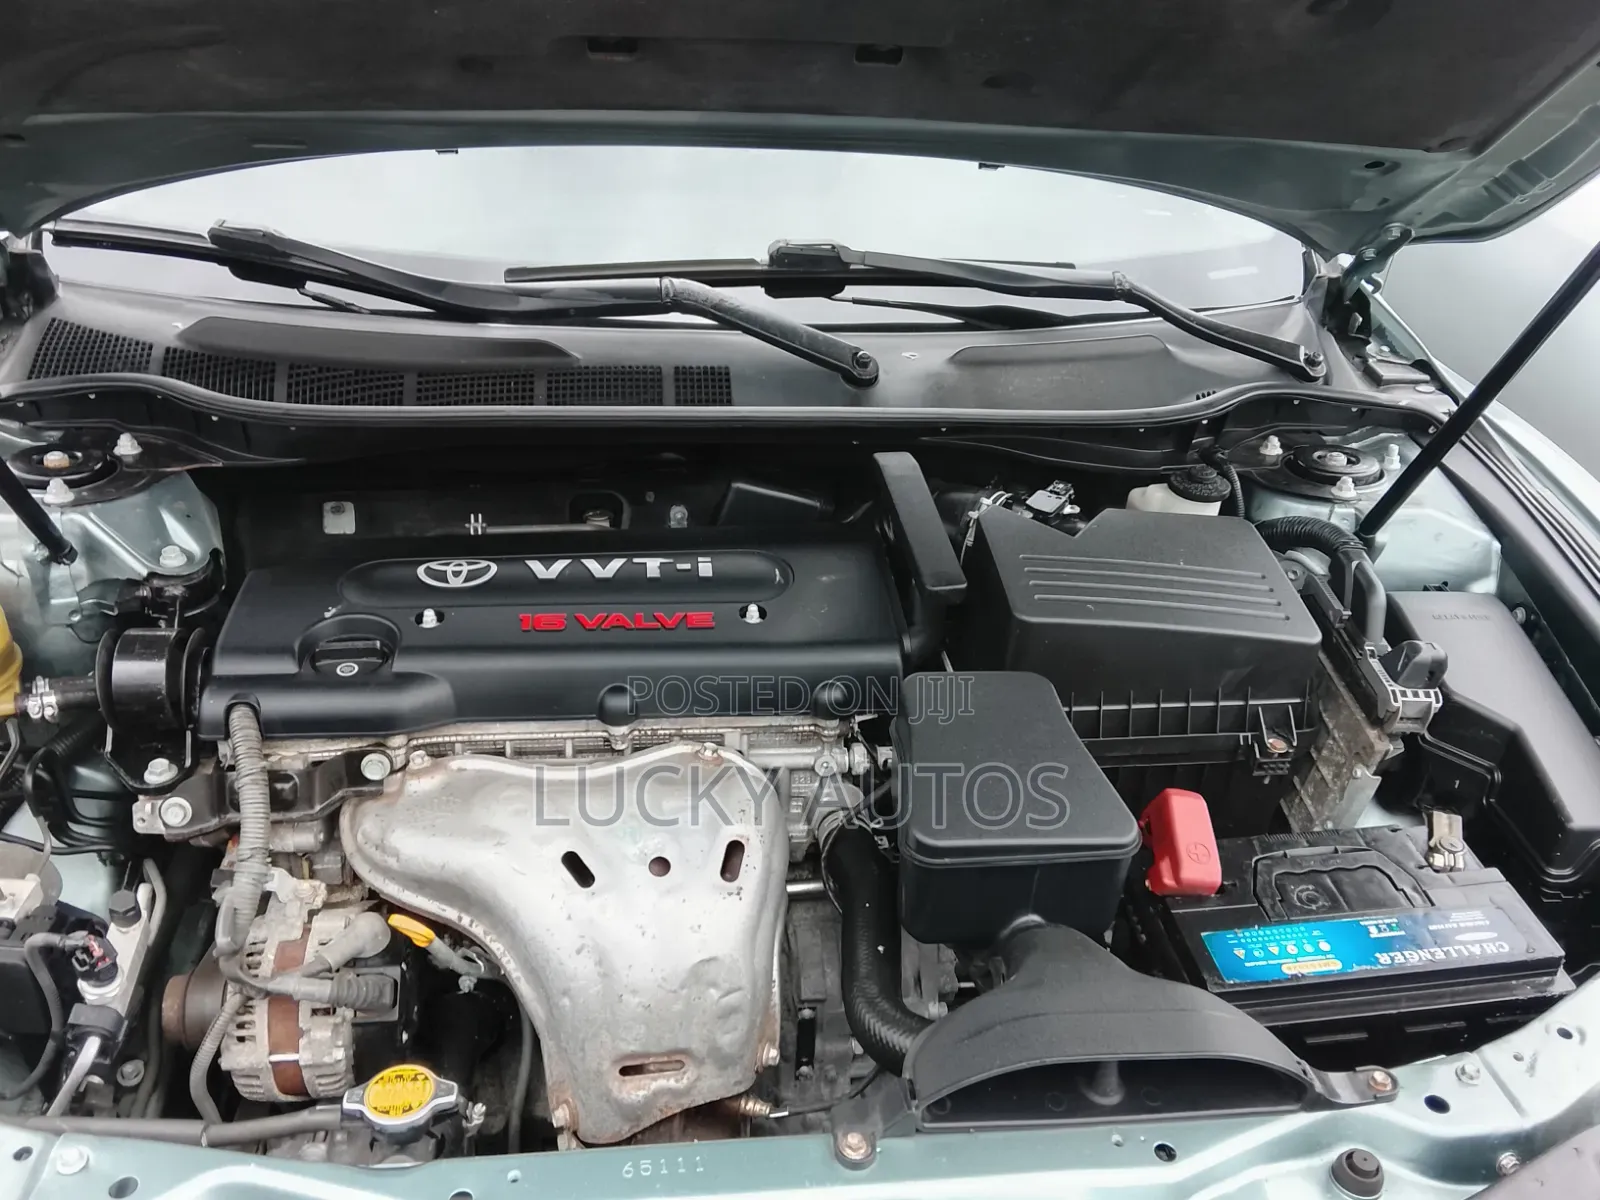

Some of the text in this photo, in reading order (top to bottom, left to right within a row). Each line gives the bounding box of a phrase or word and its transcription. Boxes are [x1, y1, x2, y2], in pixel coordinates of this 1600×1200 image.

[524, 557, 713, 579] VVT-i
[519, 612, 716, 631] 16 VALVE
[1375, 941, 1509, 964] CHALLENGER
[622, 1156, 704, 1178] 65111
